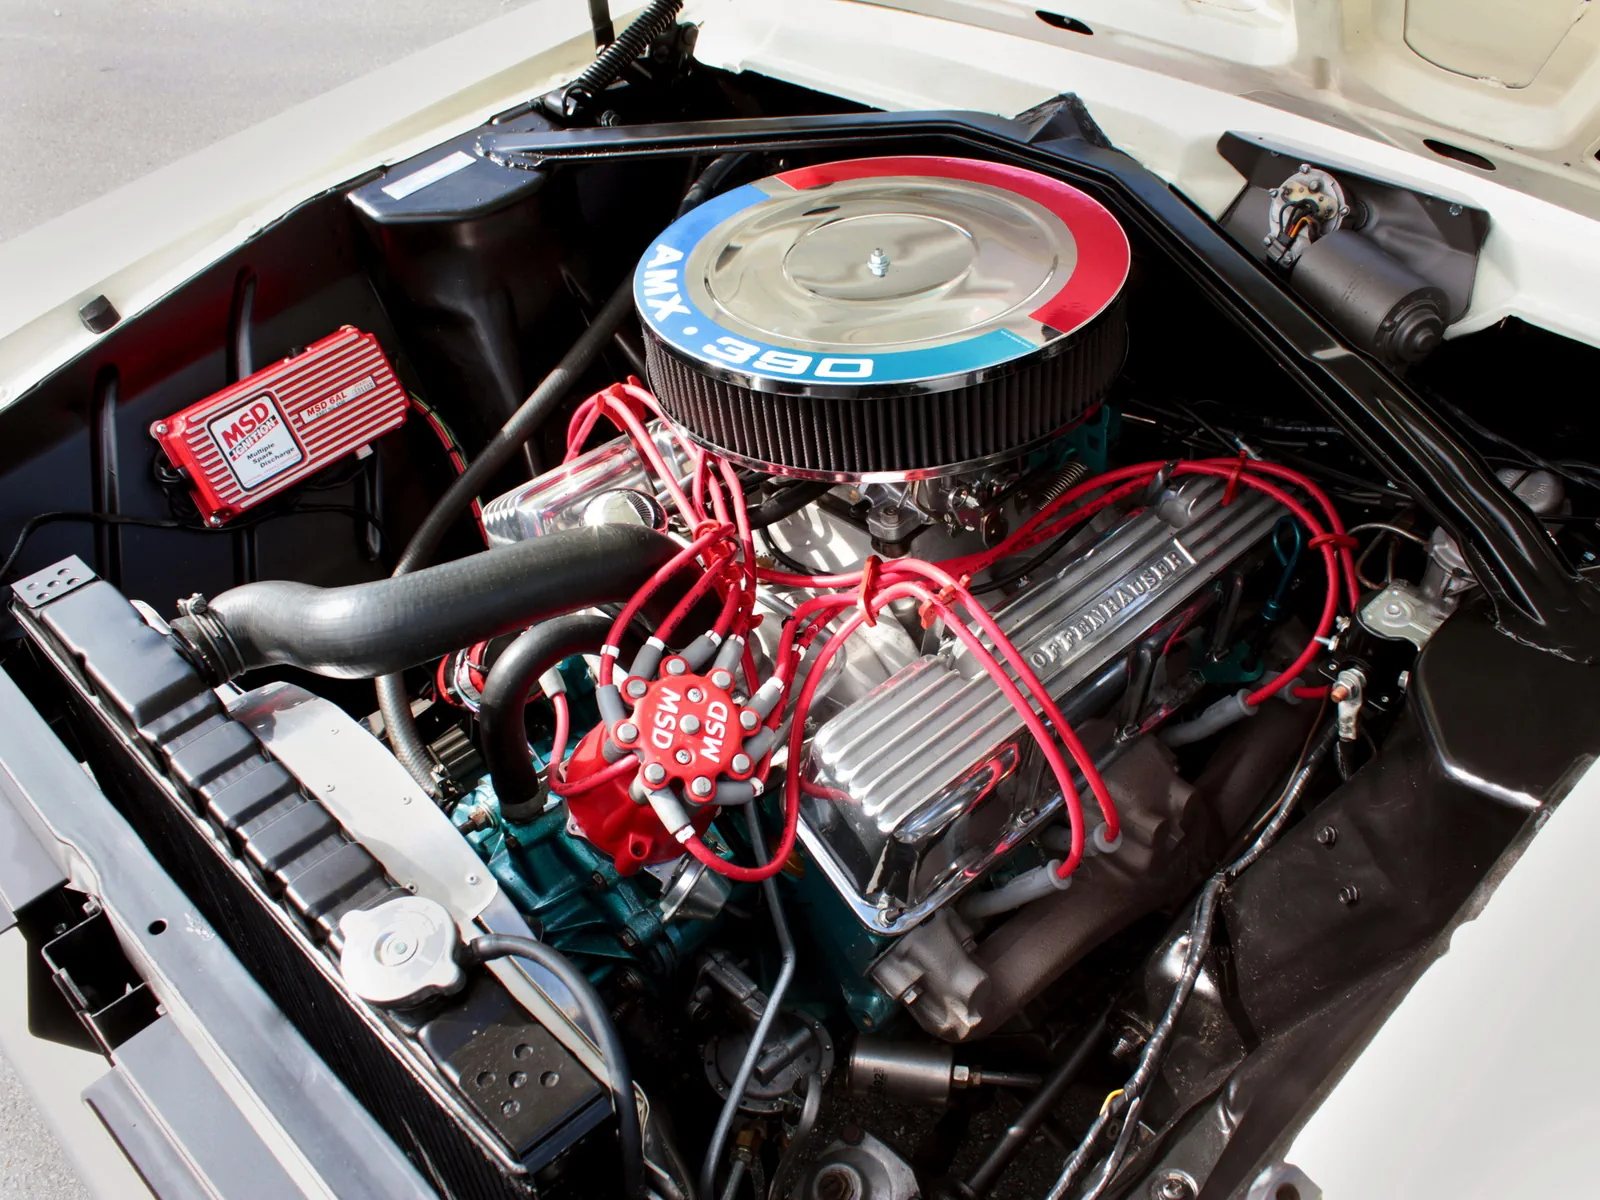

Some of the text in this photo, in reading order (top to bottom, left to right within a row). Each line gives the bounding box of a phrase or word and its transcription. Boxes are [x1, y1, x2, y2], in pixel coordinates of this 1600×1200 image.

[643, 243, 875, 378] AMX 390
[221, 402, 270, 450] MSD
[306, 401, 328, 417] MSD
[329, 391, 348, 405] 6AL
[230, 417, 278, 460] IGNITION
[246, 442, 275, 460] Multiple
[252, 451, 273, 464] Spark
[260, 447, 295, 468] Discharge
[1030, 551, 1185, 669] OFFENHAUSER
[651, 686, 682, 750] MSD
[699, 701, 729, 764] MSD
